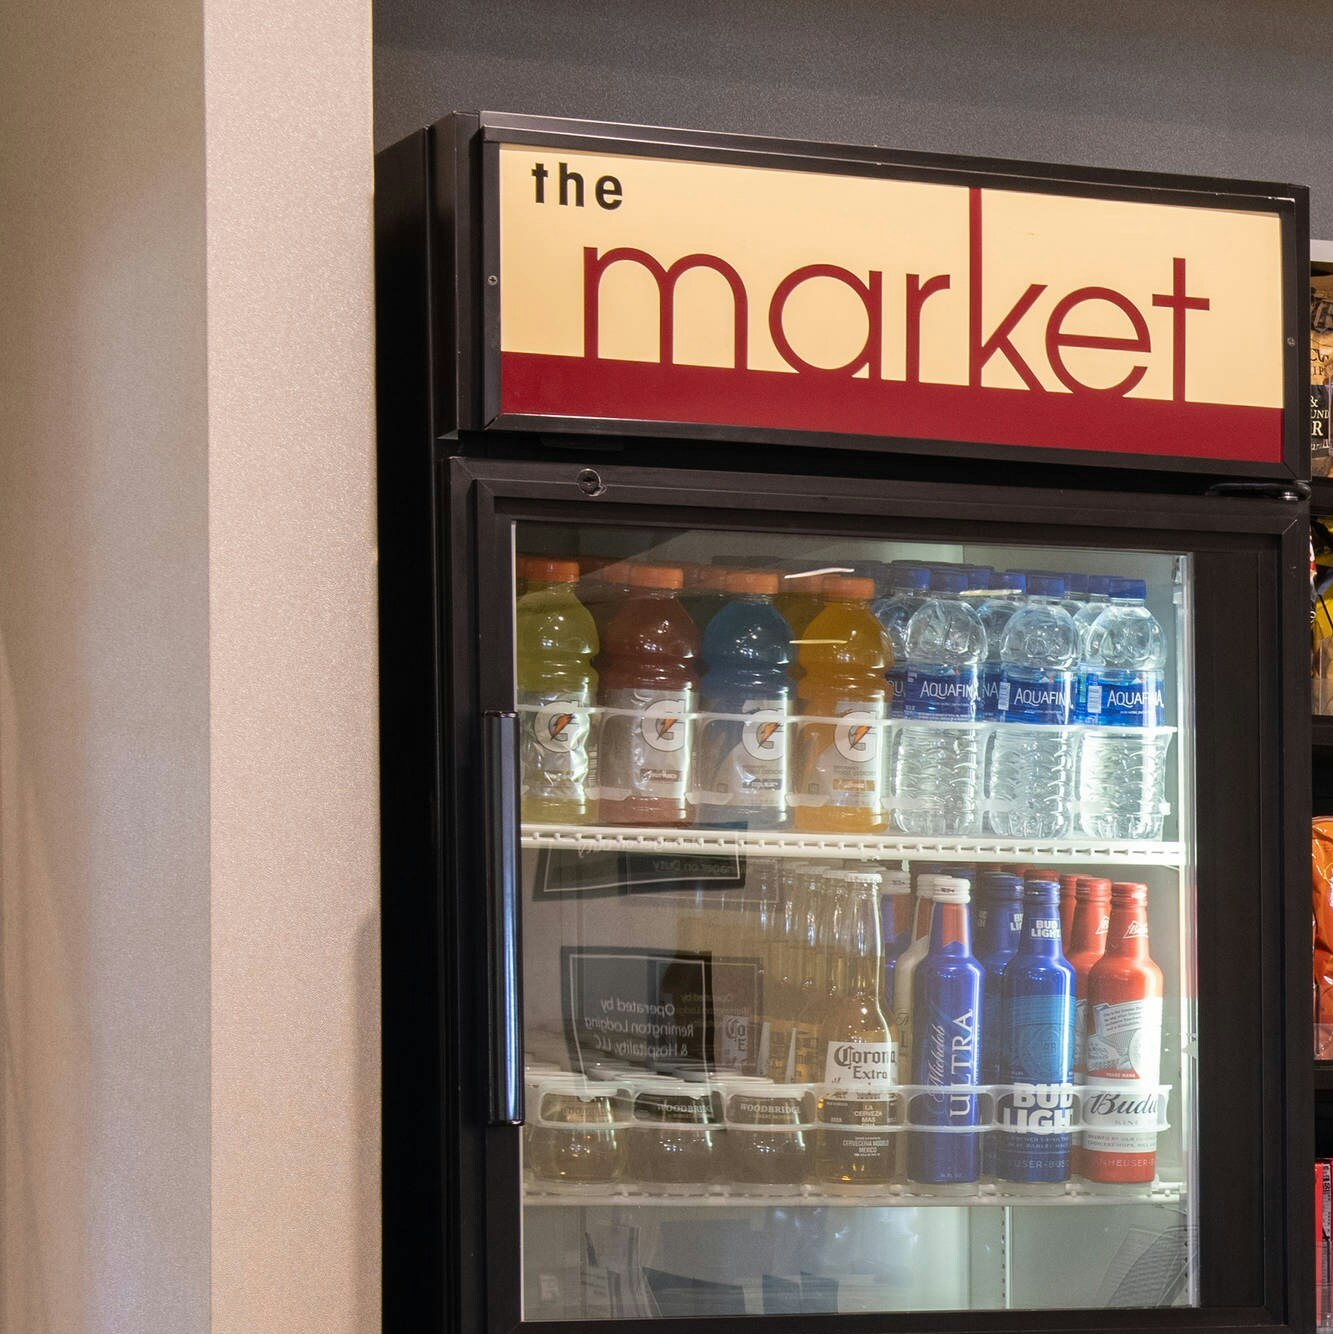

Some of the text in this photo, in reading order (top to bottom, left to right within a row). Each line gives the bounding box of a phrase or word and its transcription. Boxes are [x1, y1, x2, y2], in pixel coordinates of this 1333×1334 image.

[532, 162, 622, 210] the
[584, 187, 1210, 401] market
[1035, 919, 1058, 928] BUD
[950, 1009, 973, 1118] ULTRA
[1013, 1082, 1073, 1108] BUD
